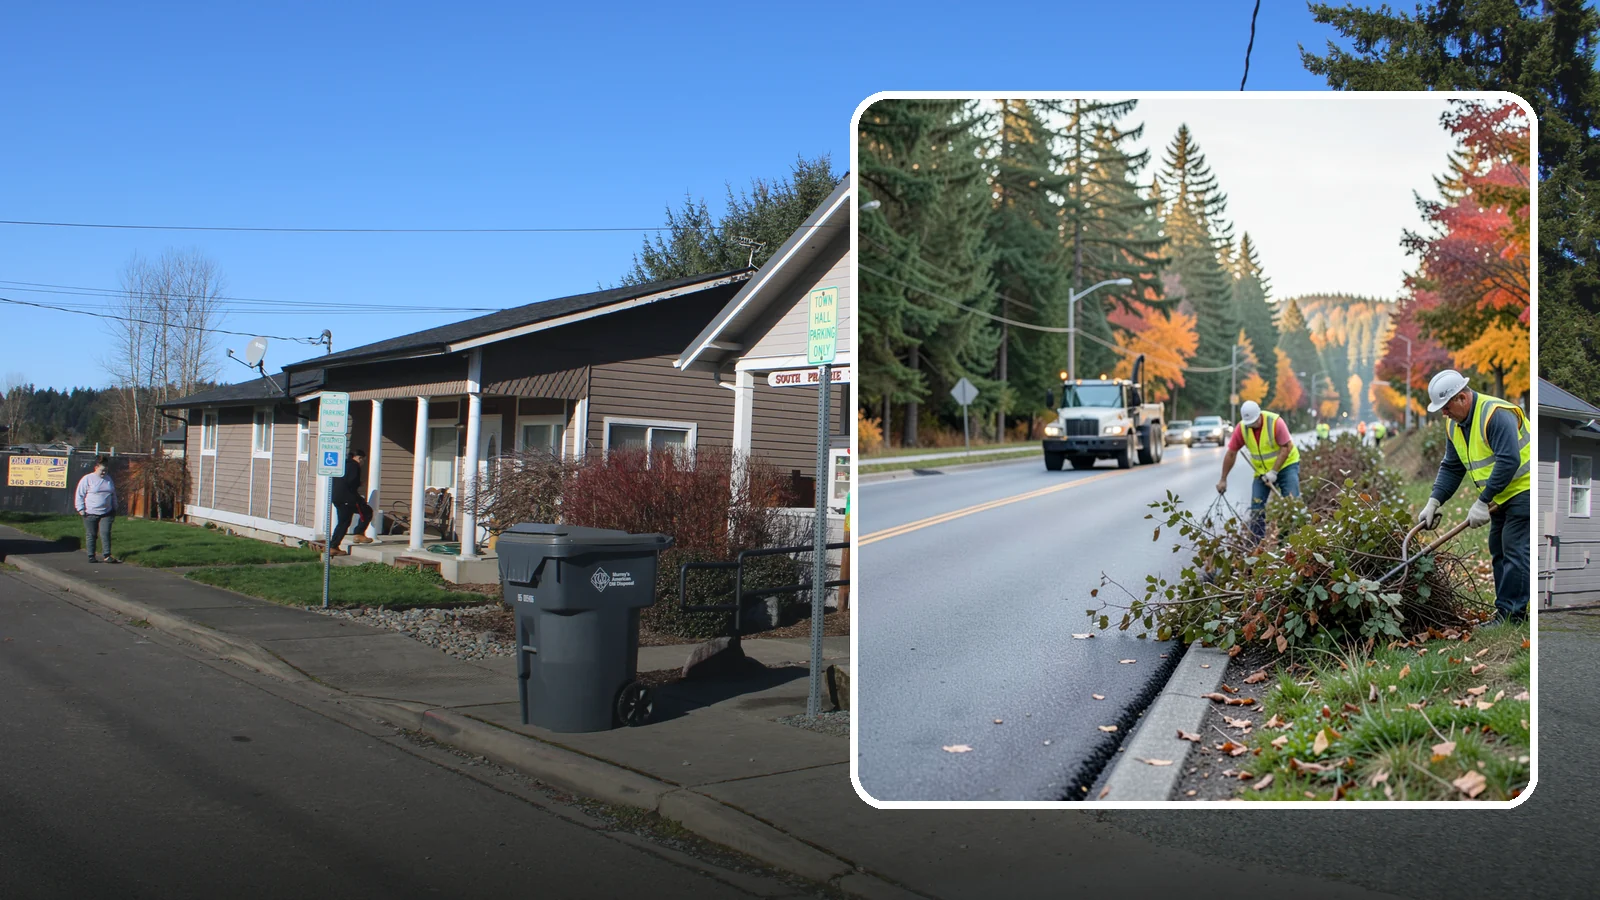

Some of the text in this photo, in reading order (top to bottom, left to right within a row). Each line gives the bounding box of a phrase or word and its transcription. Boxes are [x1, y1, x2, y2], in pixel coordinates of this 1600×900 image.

[815, 294, 833, 308] TOWN
[814, 311, 831, 324] HALL
[810, 326, 836, 341] PARKING
[813, 344, 831, 357] ONLY
[775, 373, 801, 384] SOUTH
[807, 370, 842, 382] PRIE
